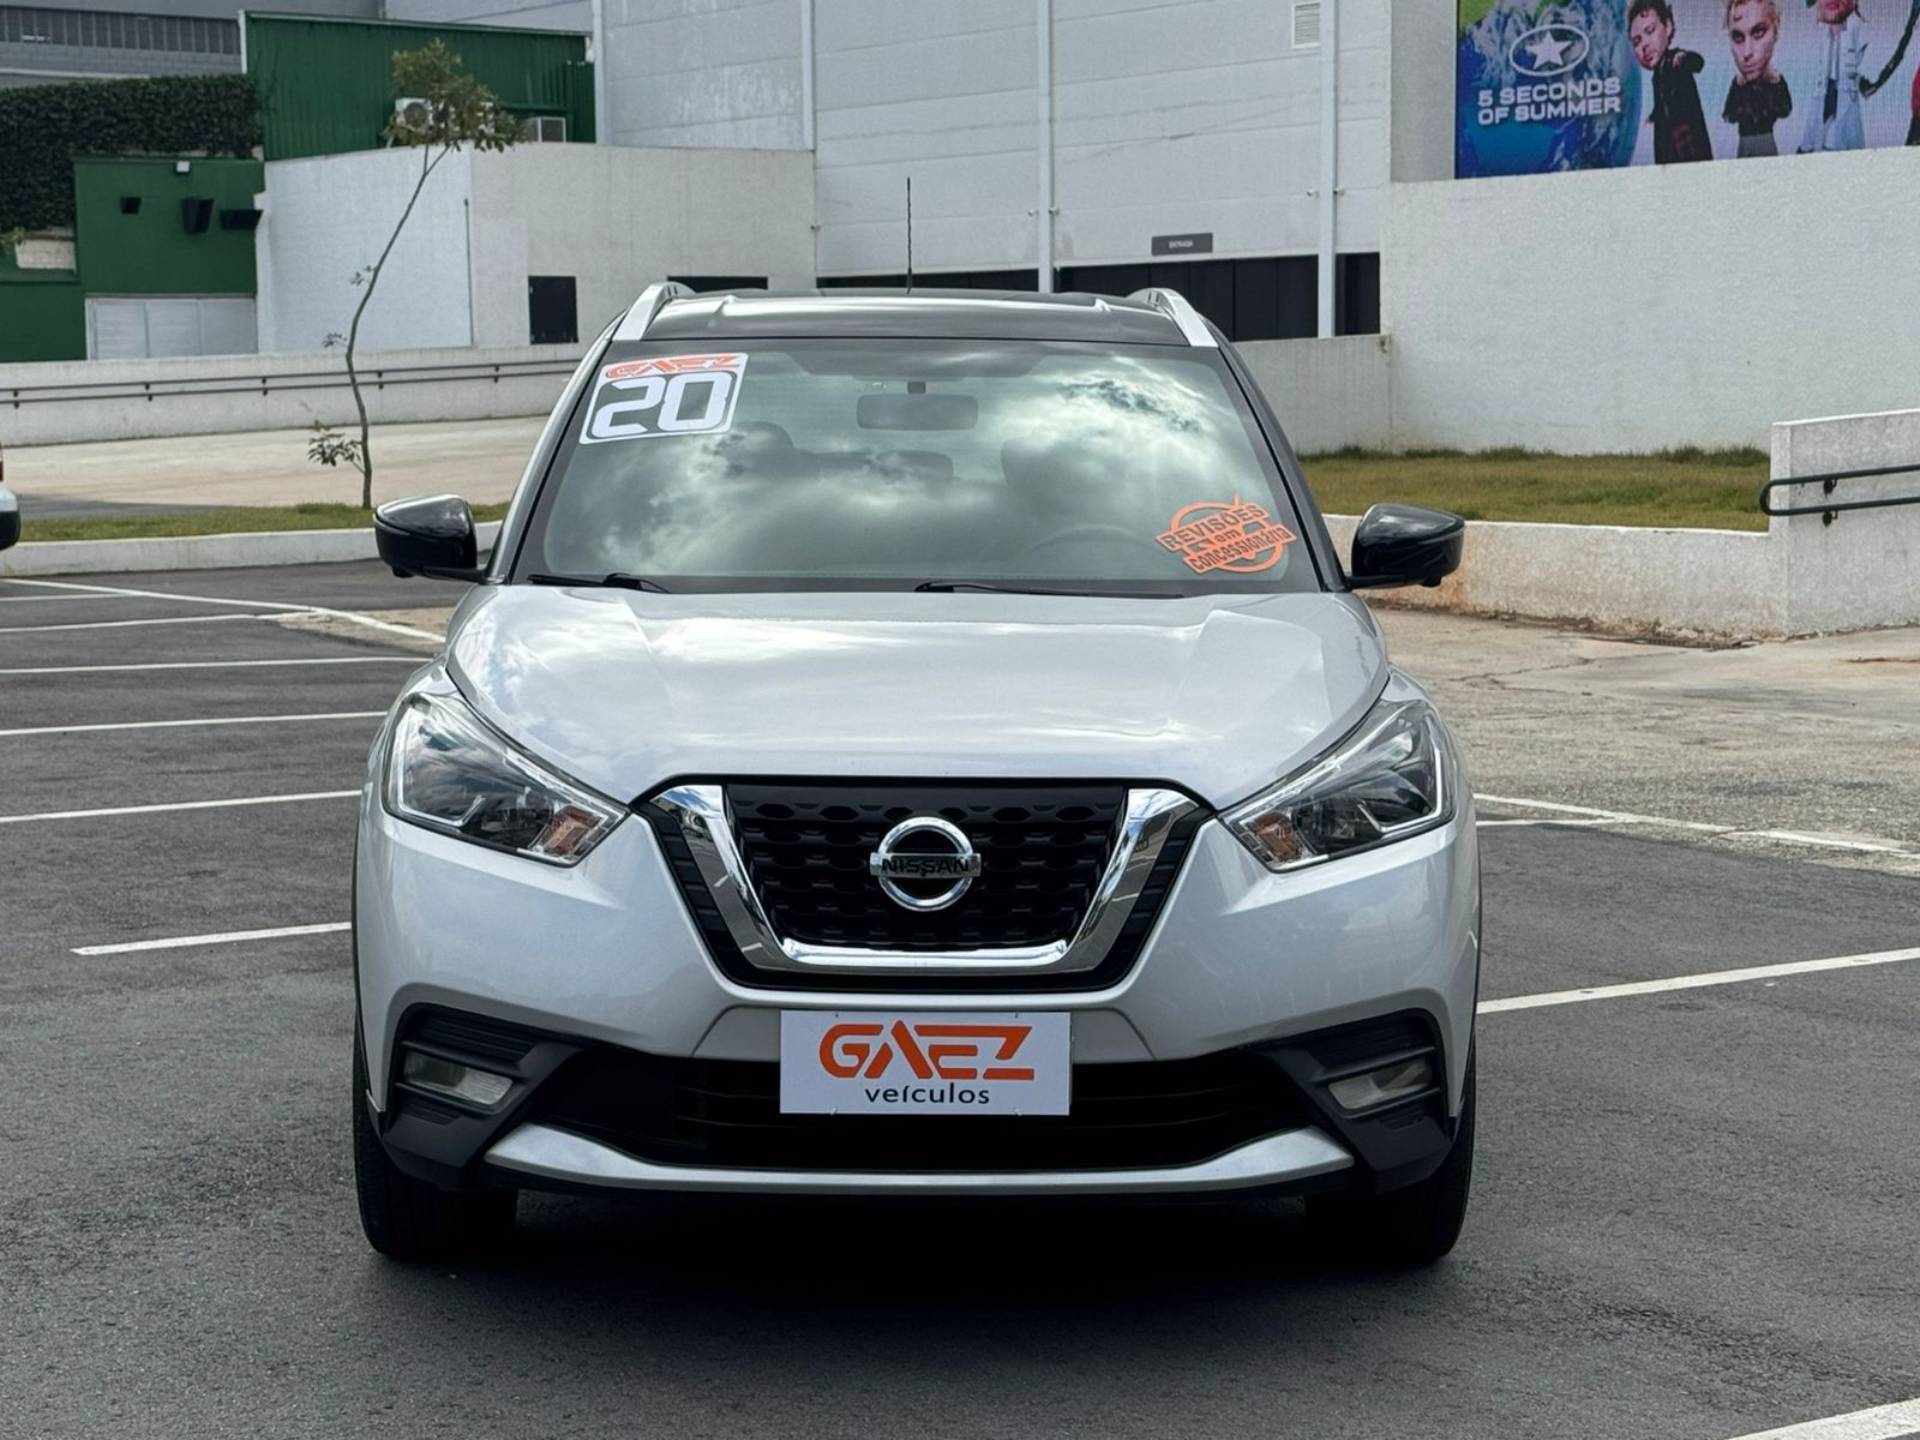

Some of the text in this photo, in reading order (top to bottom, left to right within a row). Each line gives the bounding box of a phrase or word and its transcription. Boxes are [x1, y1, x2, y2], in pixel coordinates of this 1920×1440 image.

[1478, 76, 1621, 107] 5 SECONDS
[1478, 96, 1621, 125] OF SUMMER
[592, 371, 733, 438] 20
[1160, 504, 1265, 548] REVISÕES
[1214, 529, 1242, 543] em
[881, 858, 969, 873] NISSAN
[819, 1019, 1035, 1081] GAEZ
[865, 1082, 990, 1105] veículos
